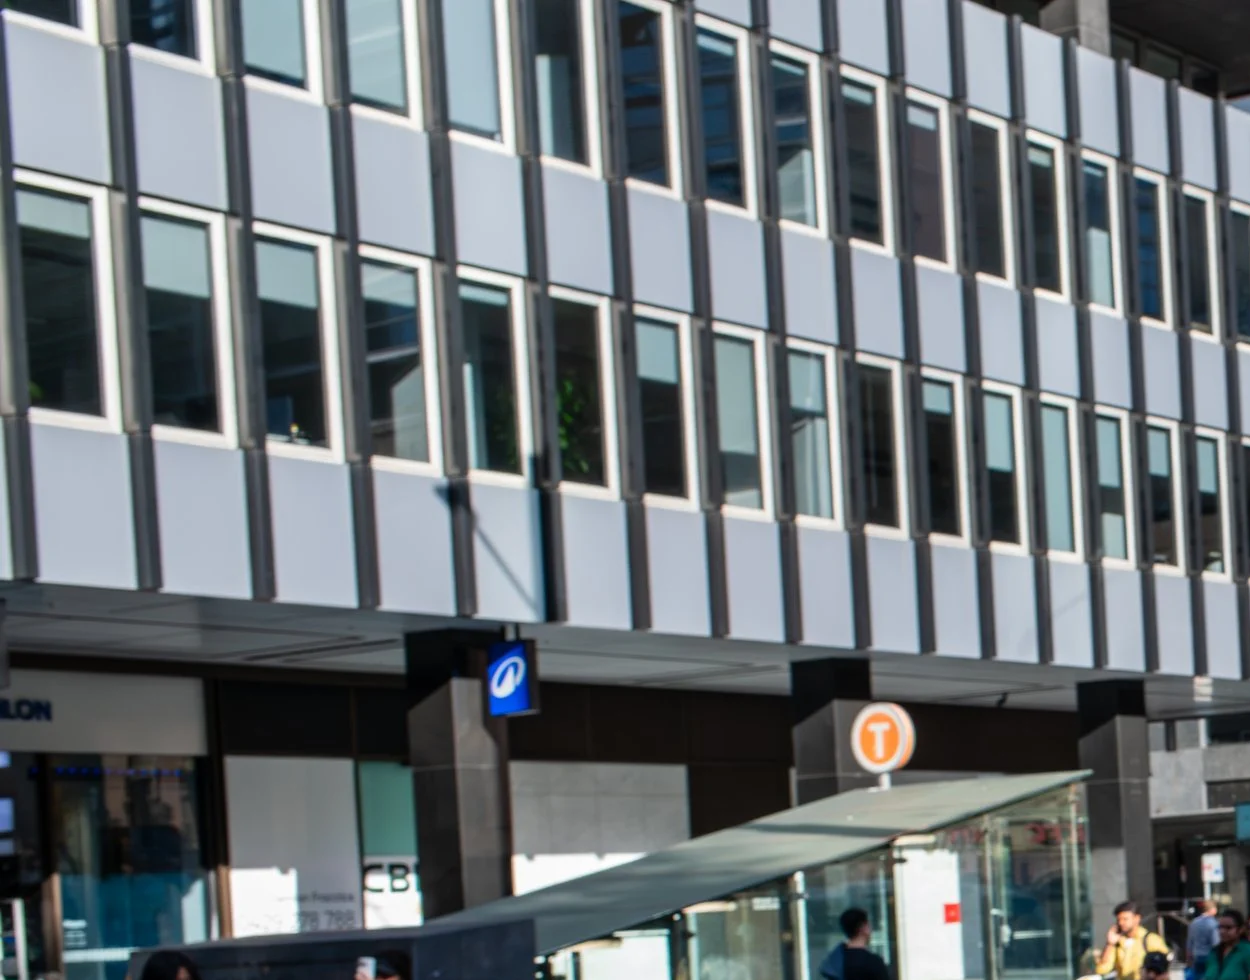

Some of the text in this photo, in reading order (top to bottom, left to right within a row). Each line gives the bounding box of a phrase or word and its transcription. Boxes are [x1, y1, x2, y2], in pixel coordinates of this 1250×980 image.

[0, 699, 51, 721] LON
[867, 723, 890, 758] T
[363, 863, 420, 893] CB
